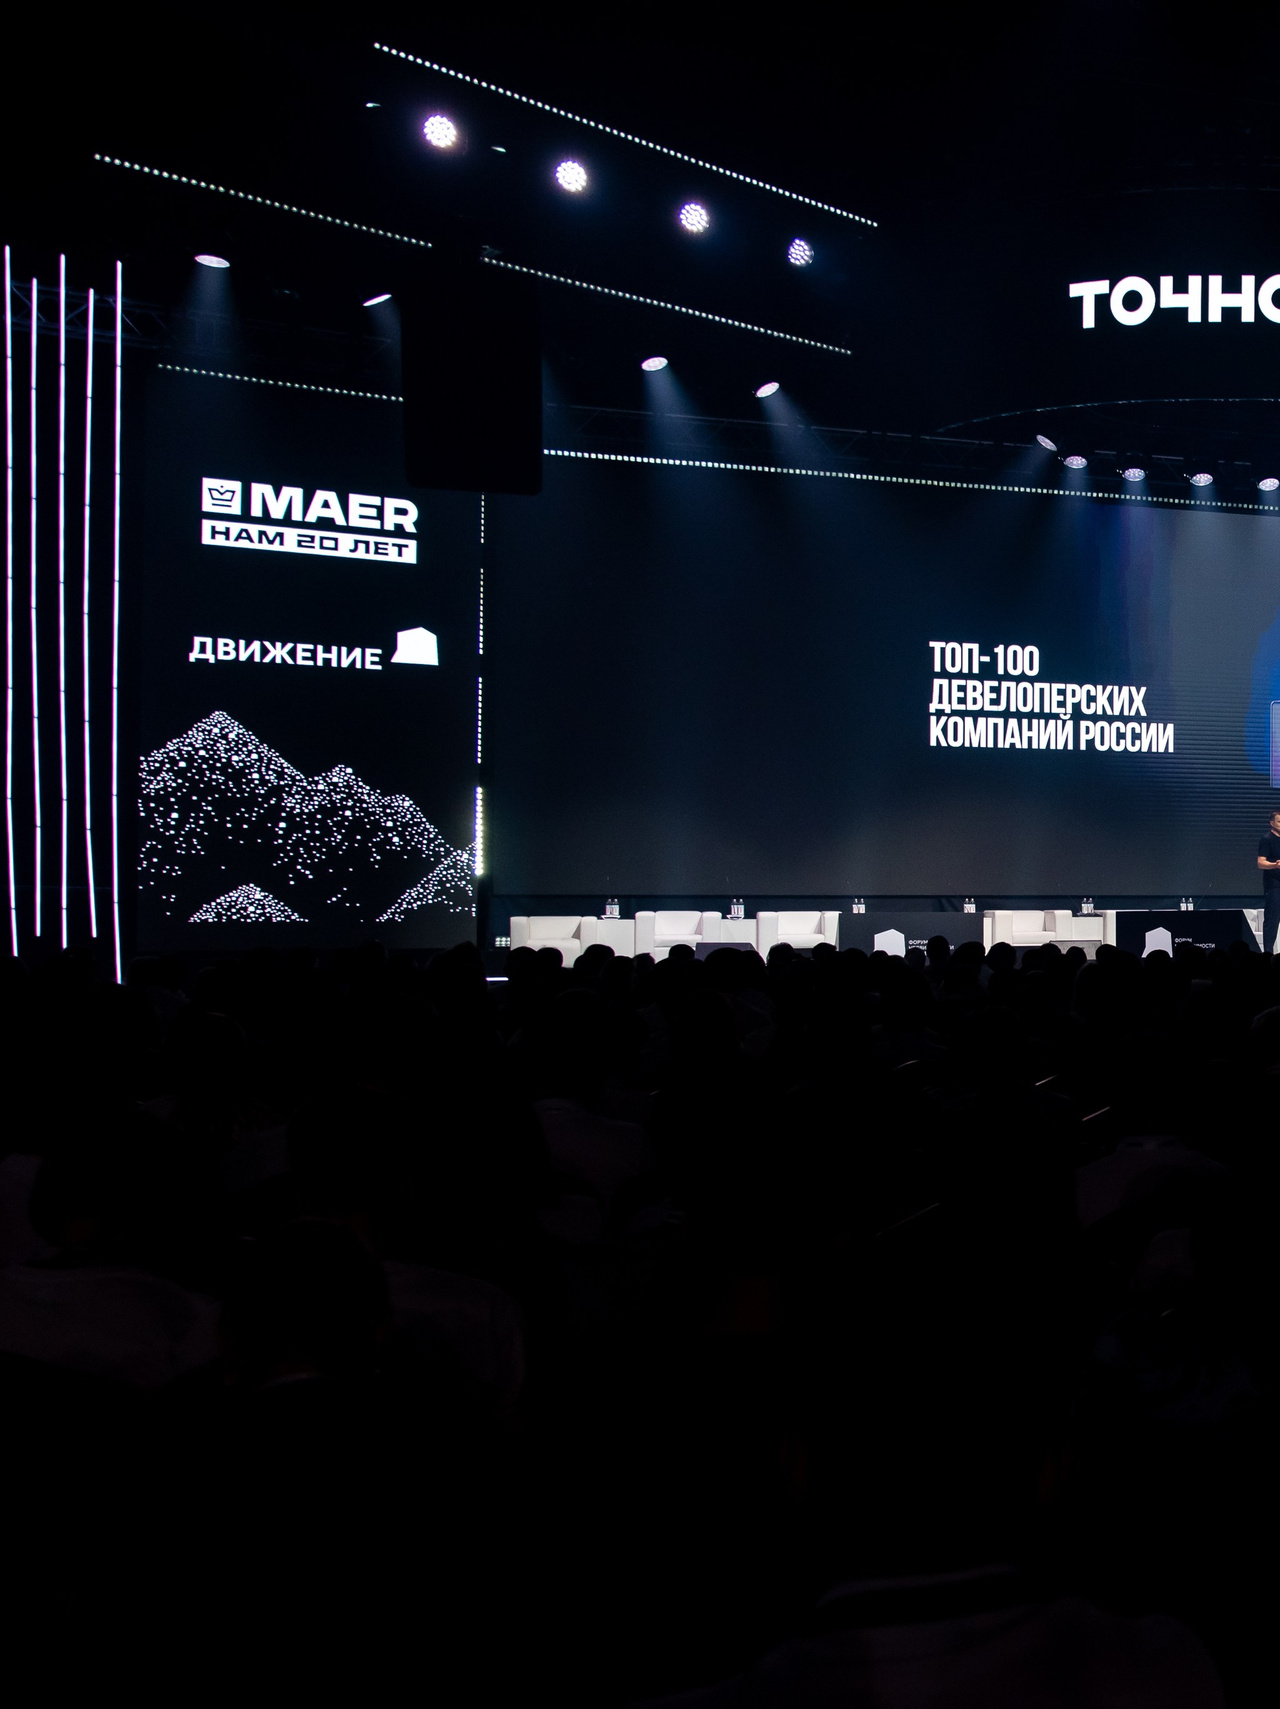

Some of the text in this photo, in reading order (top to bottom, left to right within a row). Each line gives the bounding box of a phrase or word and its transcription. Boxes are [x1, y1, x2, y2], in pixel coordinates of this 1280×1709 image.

[250, 482, 419, 533] MAER
[210, 525, 410, 558] НАМ 20 ЛЕТ
[188, 635, 383, 671] ДВИЖЕНИЕ
[929, 641, 1040, 676] ТОП-100
[929, 678, 1148, 717] ДЕВЕЛОПЕРСКИХ
[929, 713, 1175, 753] КОМПАНИЙ РОССИИ
